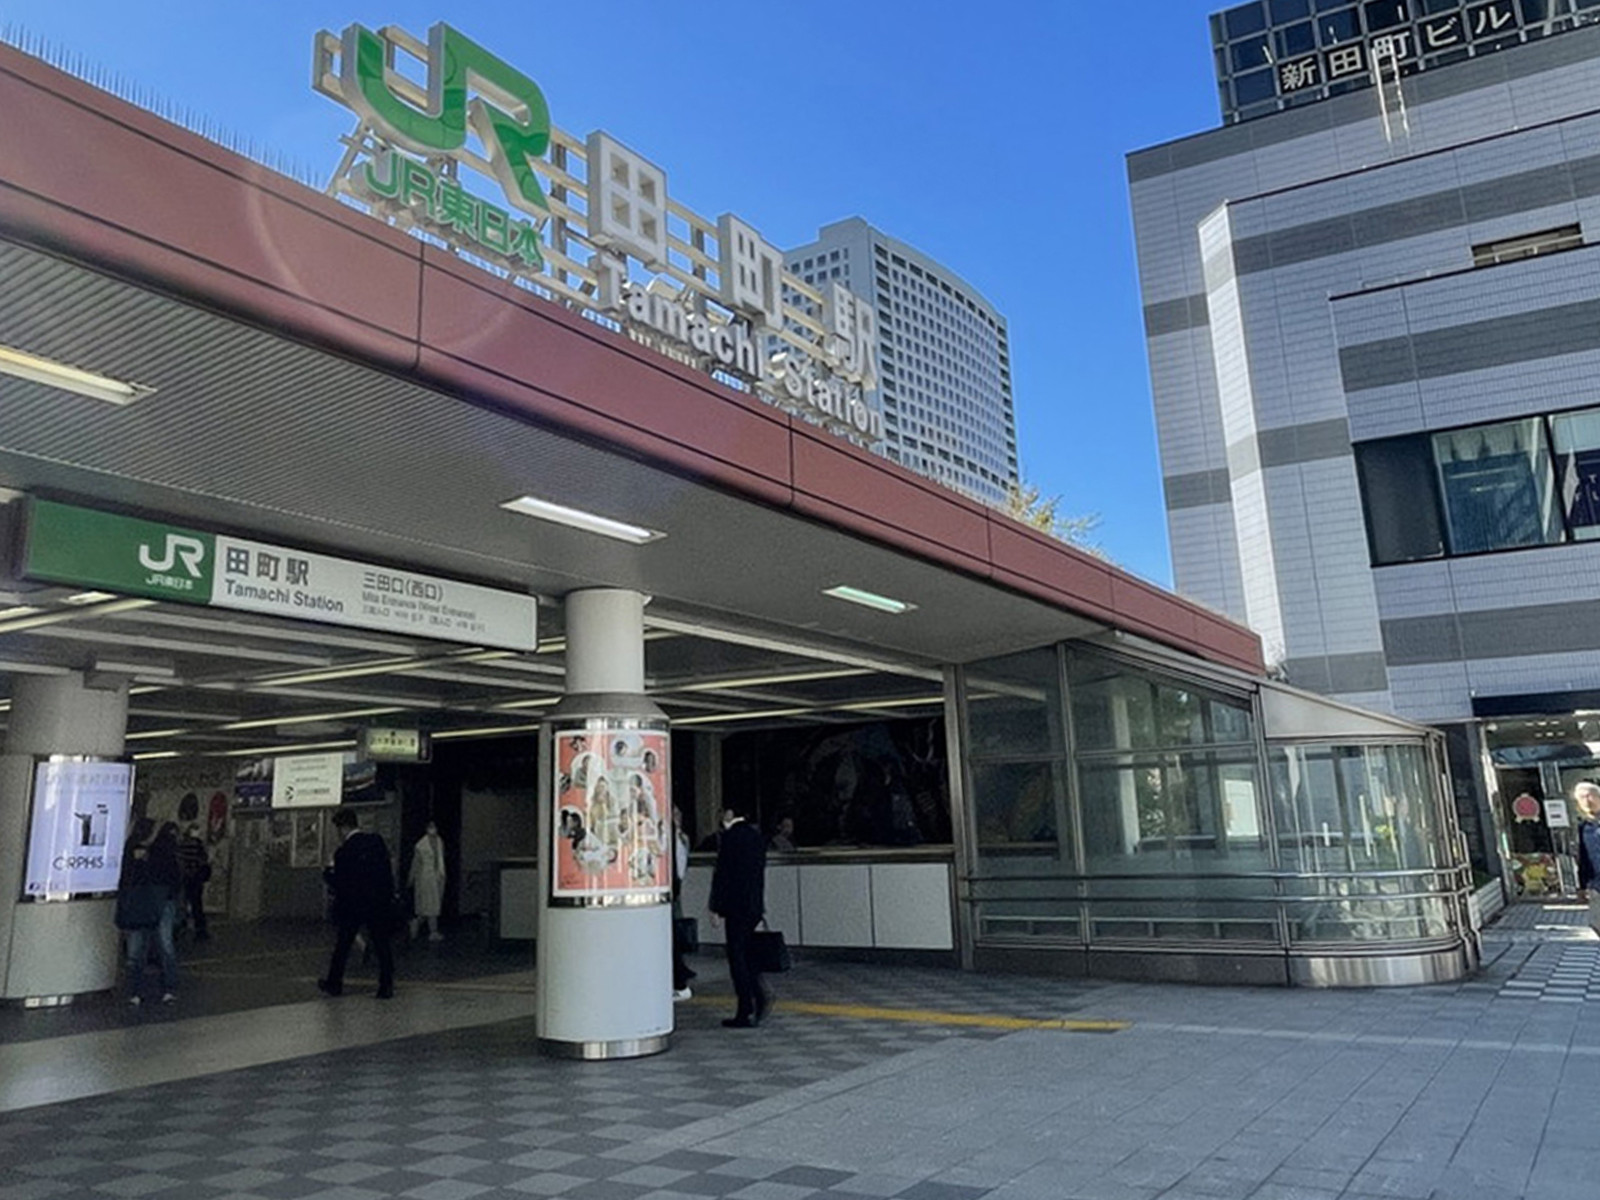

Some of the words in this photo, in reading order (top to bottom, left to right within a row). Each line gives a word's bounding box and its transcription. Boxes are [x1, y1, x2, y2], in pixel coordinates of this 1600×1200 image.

[1281, 5, 1512, 90] 新田町ビル
[344, 21, 551, 220] JR
[364, 151, 544, 272] JR東日本
[594, 131, 878, 390] 田町駅
[596, 252, 765, 382] Tamachi
[783, 355, 884, 438] Station
[139, 533, 204, 578] JR
[225, 546, 309, 586] 田町駅
[225, 579, 290, 605] Tamachi
[292, 591, 344, 613] Station
[362, 571, 444, 602] 三田口(西口)
